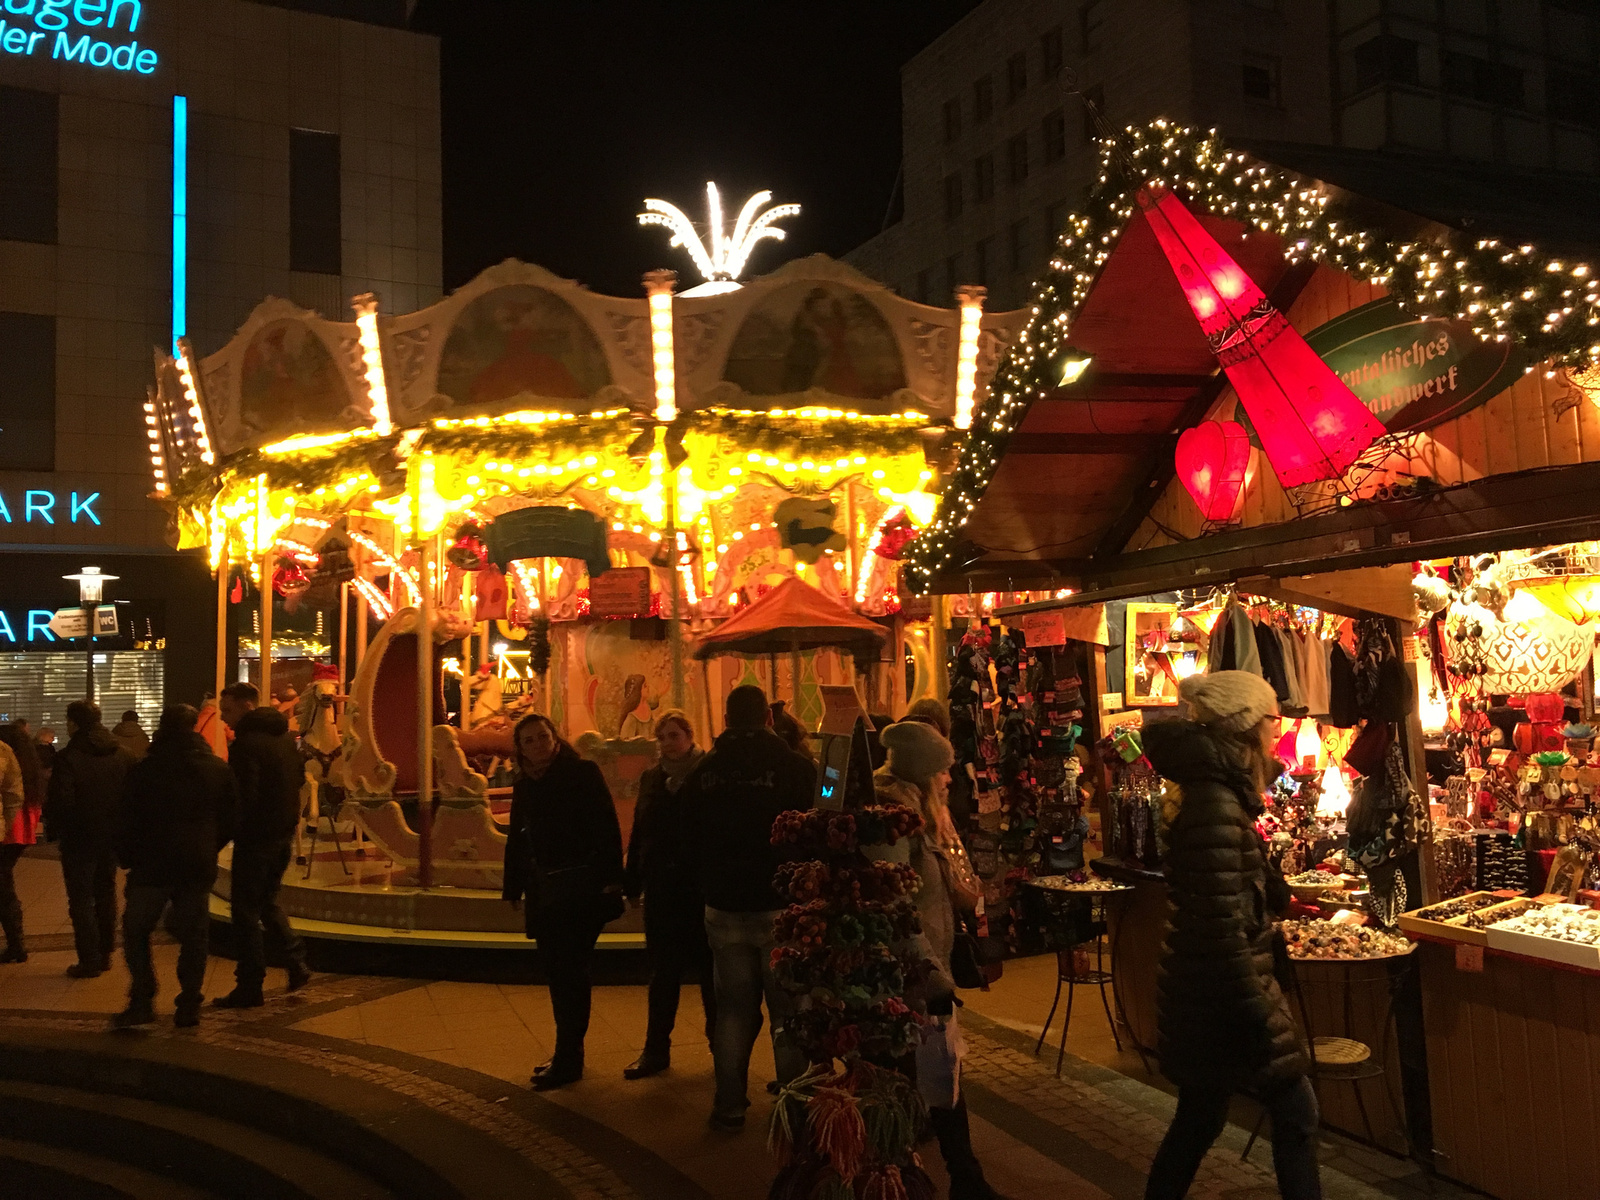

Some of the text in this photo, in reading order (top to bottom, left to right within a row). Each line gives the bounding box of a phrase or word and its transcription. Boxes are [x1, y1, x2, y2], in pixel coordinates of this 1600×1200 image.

[0, 0, 142, 32] agen
[52, 31, 158, 74] Mode
[99, 616, 114, 626] WC
